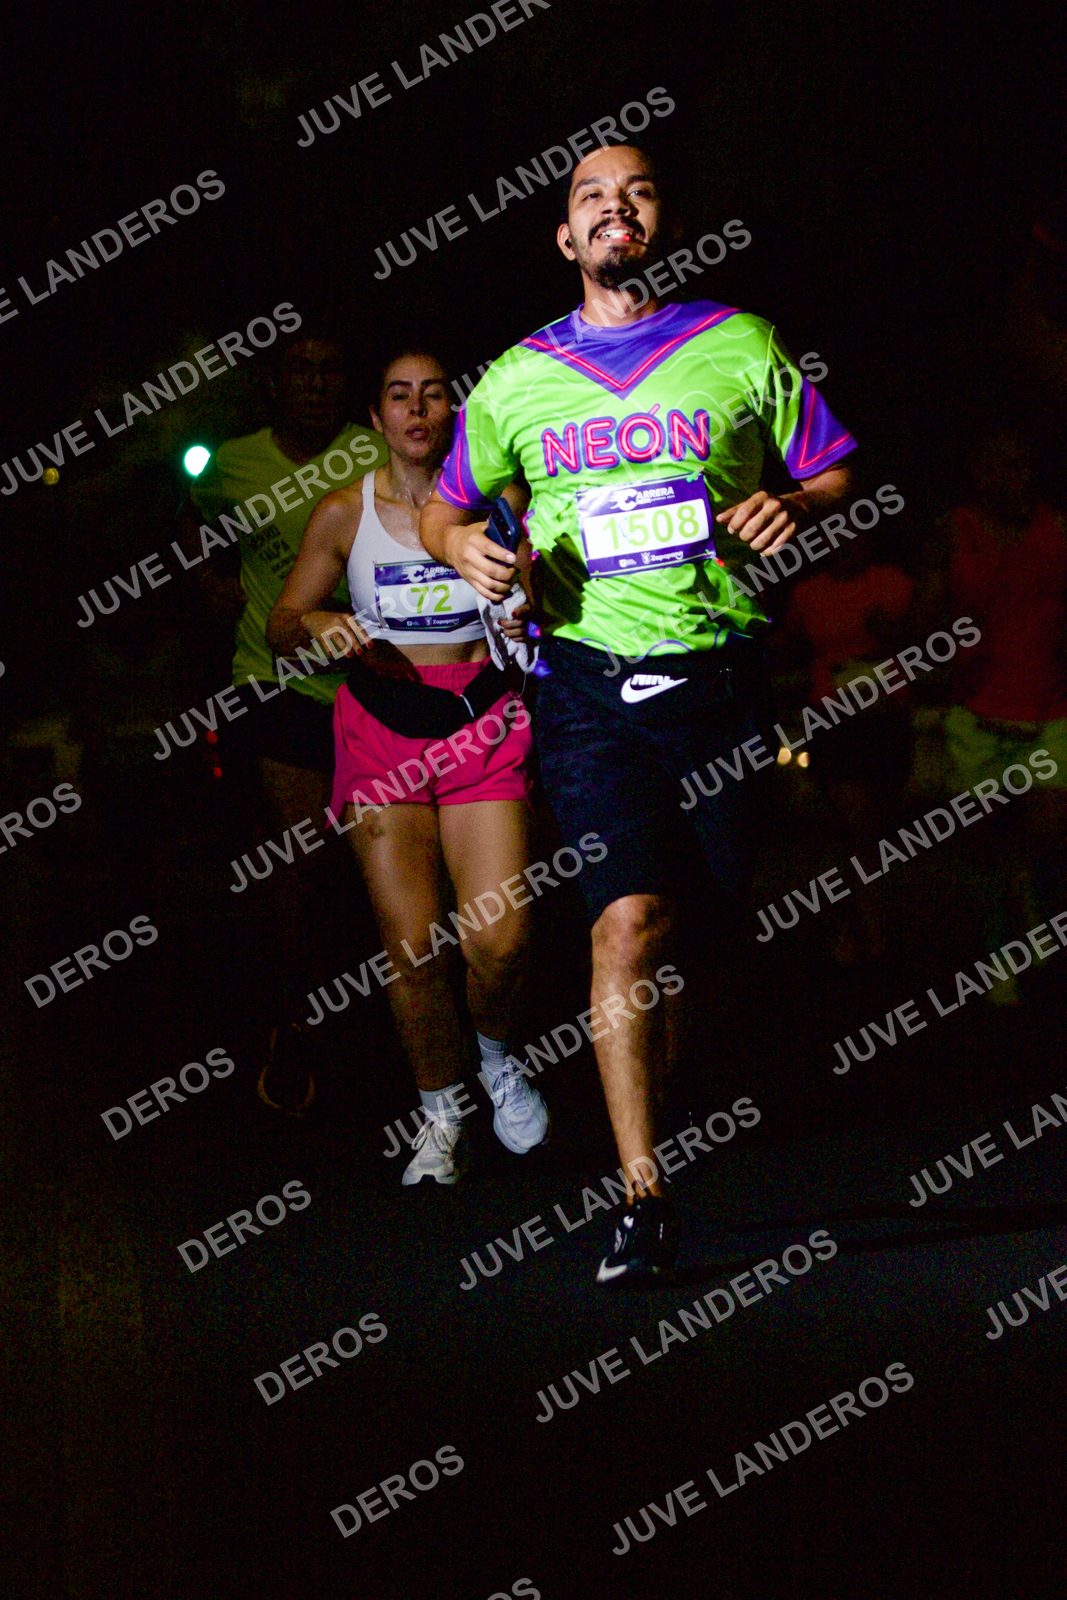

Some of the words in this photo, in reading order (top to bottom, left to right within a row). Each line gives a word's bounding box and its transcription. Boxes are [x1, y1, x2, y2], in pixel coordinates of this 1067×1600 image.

[541, 403, 711, 477] NEÓN
[608, 486, 675, 511] CARRERA
[603, 505, 700, 550] 1508
[410, 584, 453, 614] 72
